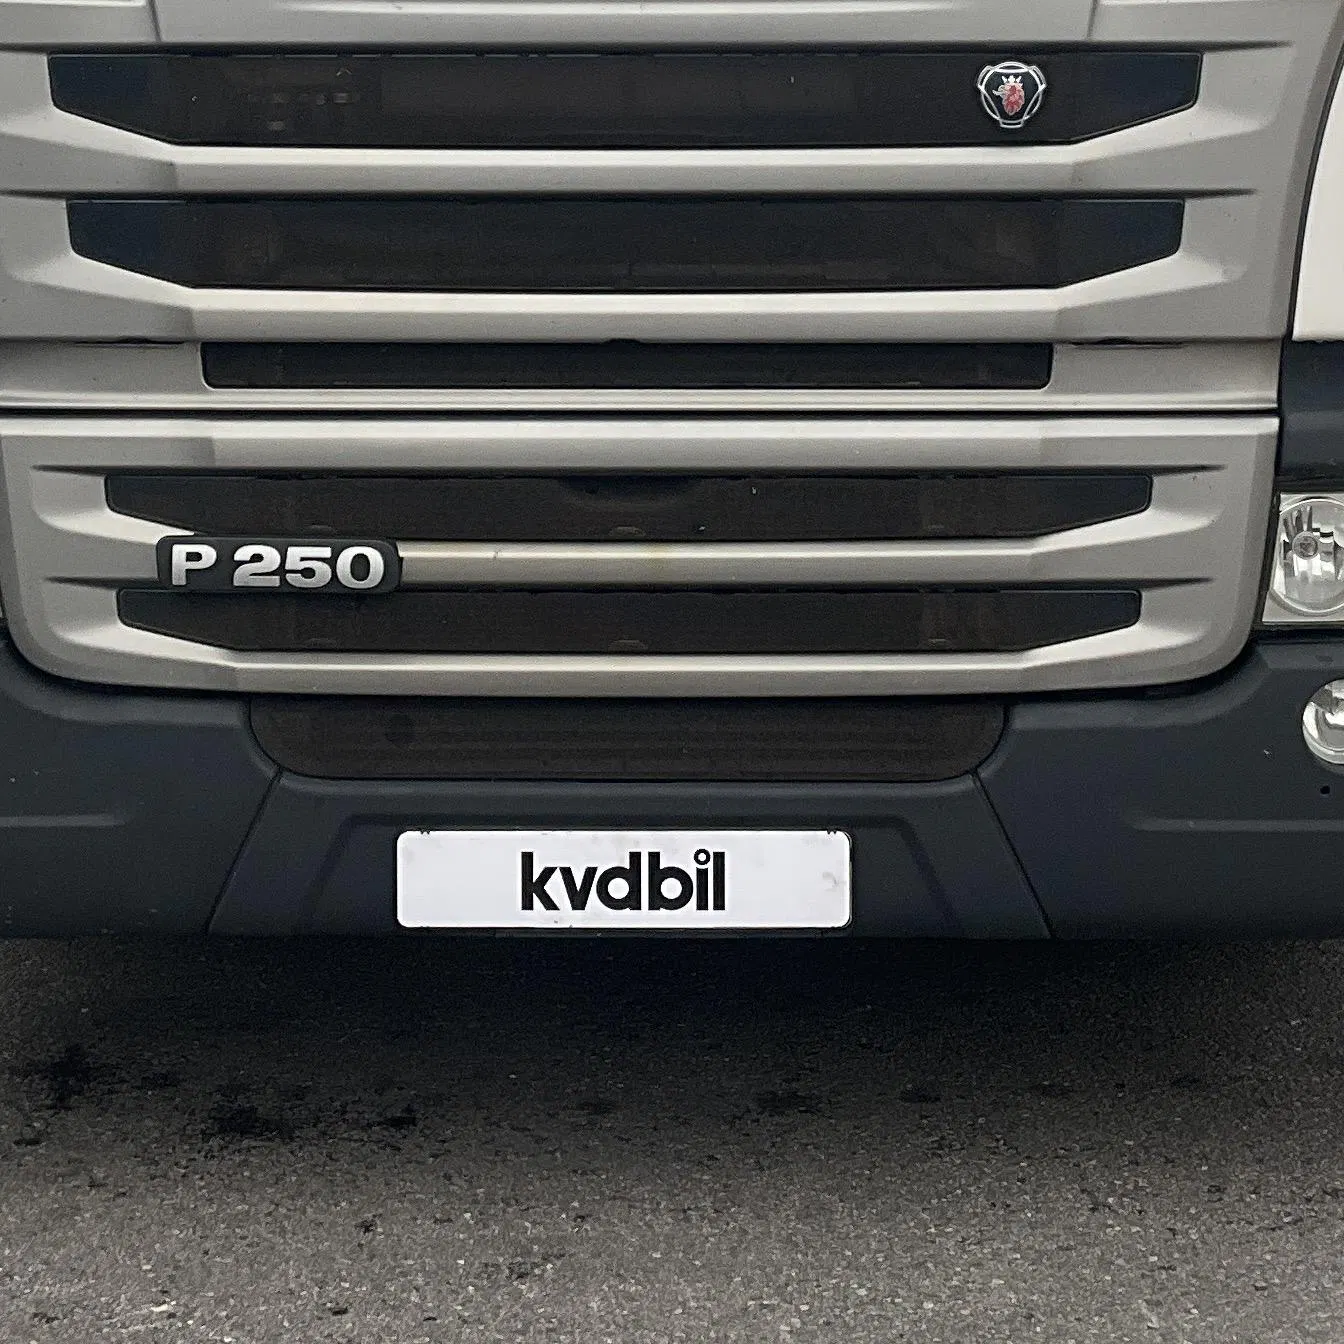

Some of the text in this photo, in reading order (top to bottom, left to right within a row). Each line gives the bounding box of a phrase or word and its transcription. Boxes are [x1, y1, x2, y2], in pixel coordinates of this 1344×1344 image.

[171, 544, 385, 590] P 250
[521, 848, 726, 911] kvdbil
